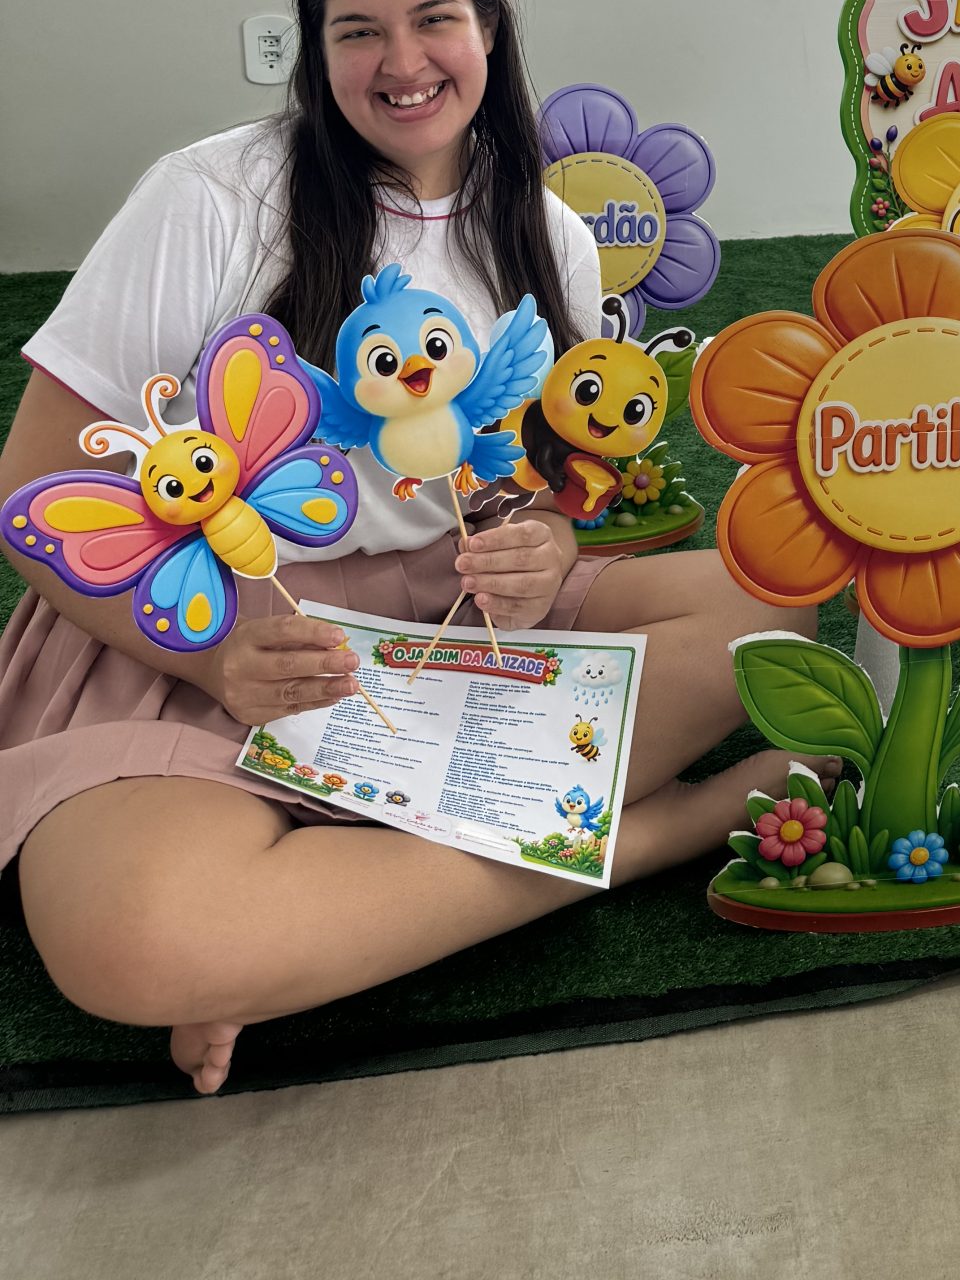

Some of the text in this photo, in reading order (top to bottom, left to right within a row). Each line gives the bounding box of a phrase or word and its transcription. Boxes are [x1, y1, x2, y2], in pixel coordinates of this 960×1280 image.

[580, 201, 659, 244] dão
[394, 648, 406, 661] O
[461, 650, 482, 666] DA
